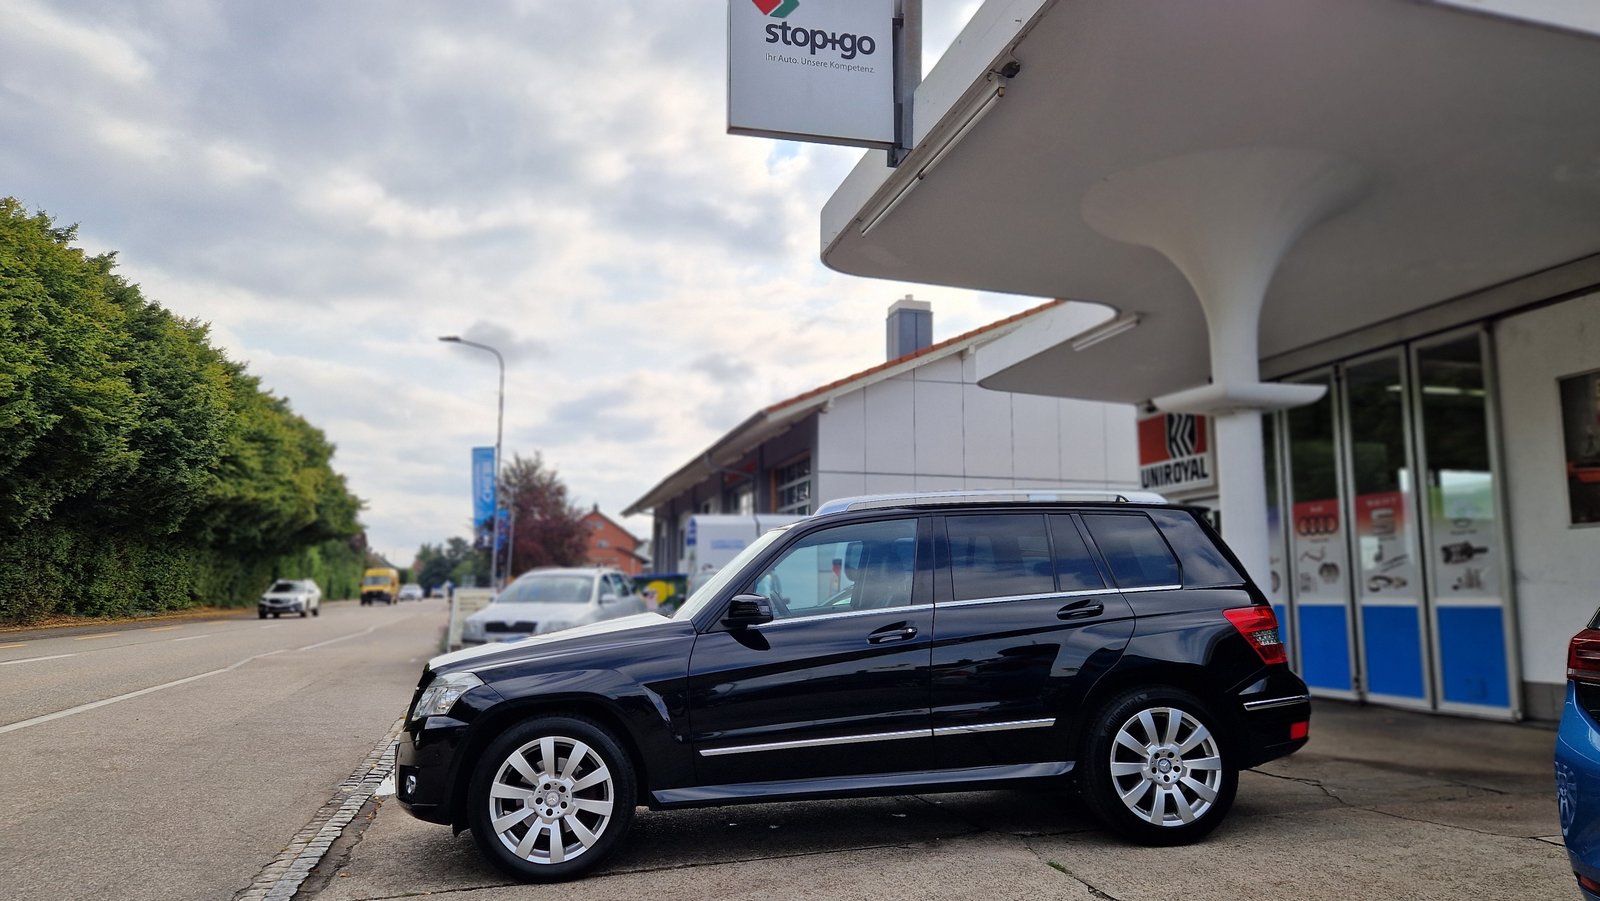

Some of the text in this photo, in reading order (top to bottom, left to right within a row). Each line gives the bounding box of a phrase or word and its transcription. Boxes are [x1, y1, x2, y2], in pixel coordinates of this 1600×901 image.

[765, 21, 876, 60] stop+go
[765, 53, 876, 73] Ihr Auto. Unsere Kompetenz.
[1141, 457, 1209, 489] UNIROYAL
